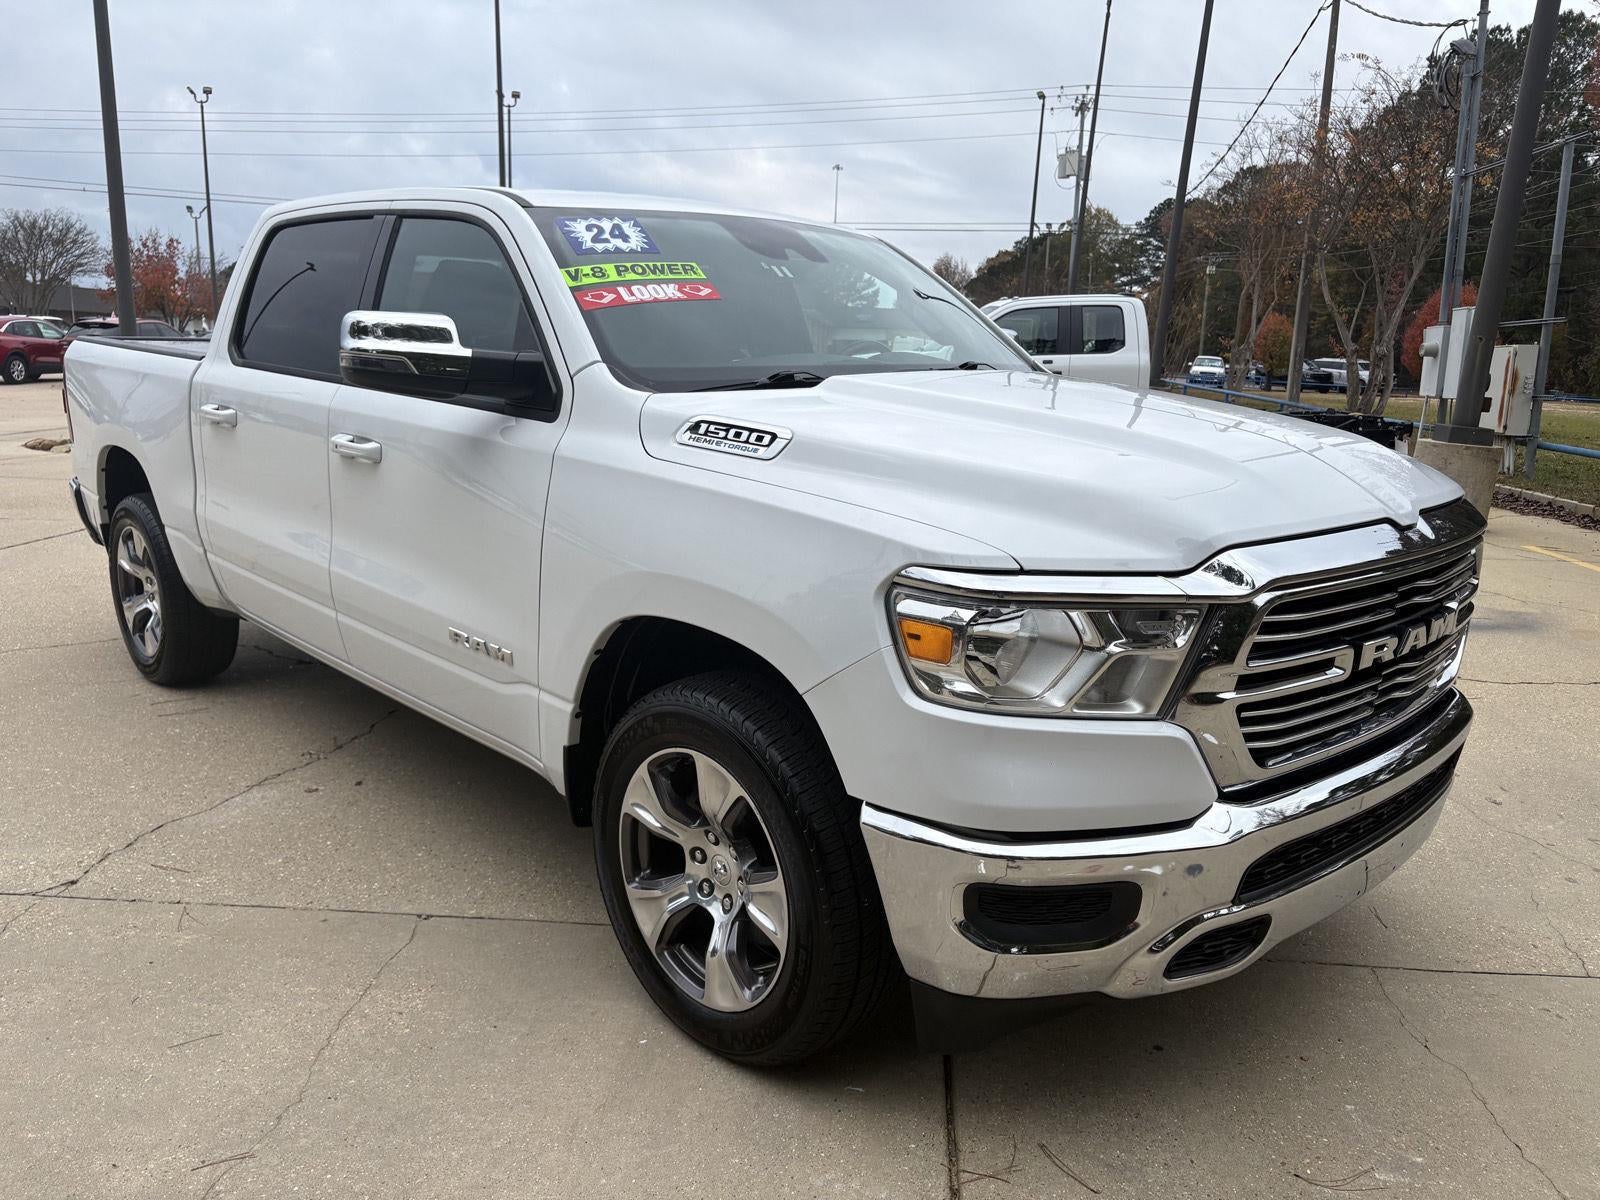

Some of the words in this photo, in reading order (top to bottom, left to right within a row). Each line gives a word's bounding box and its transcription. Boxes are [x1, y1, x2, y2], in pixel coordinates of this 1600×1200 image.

[585, 222, 630, 244] 24
[565, 266, 608, 283] V-8
[615, 263, 700, 278] POWER
[617, 283, 688, 302] LOOK
[688, 435, 714, 446] HEMI
[698, 422, 772, 446] 1500
[448, 627, 514, 667] RAM
[1359, 608, 1458, 671] RAM
